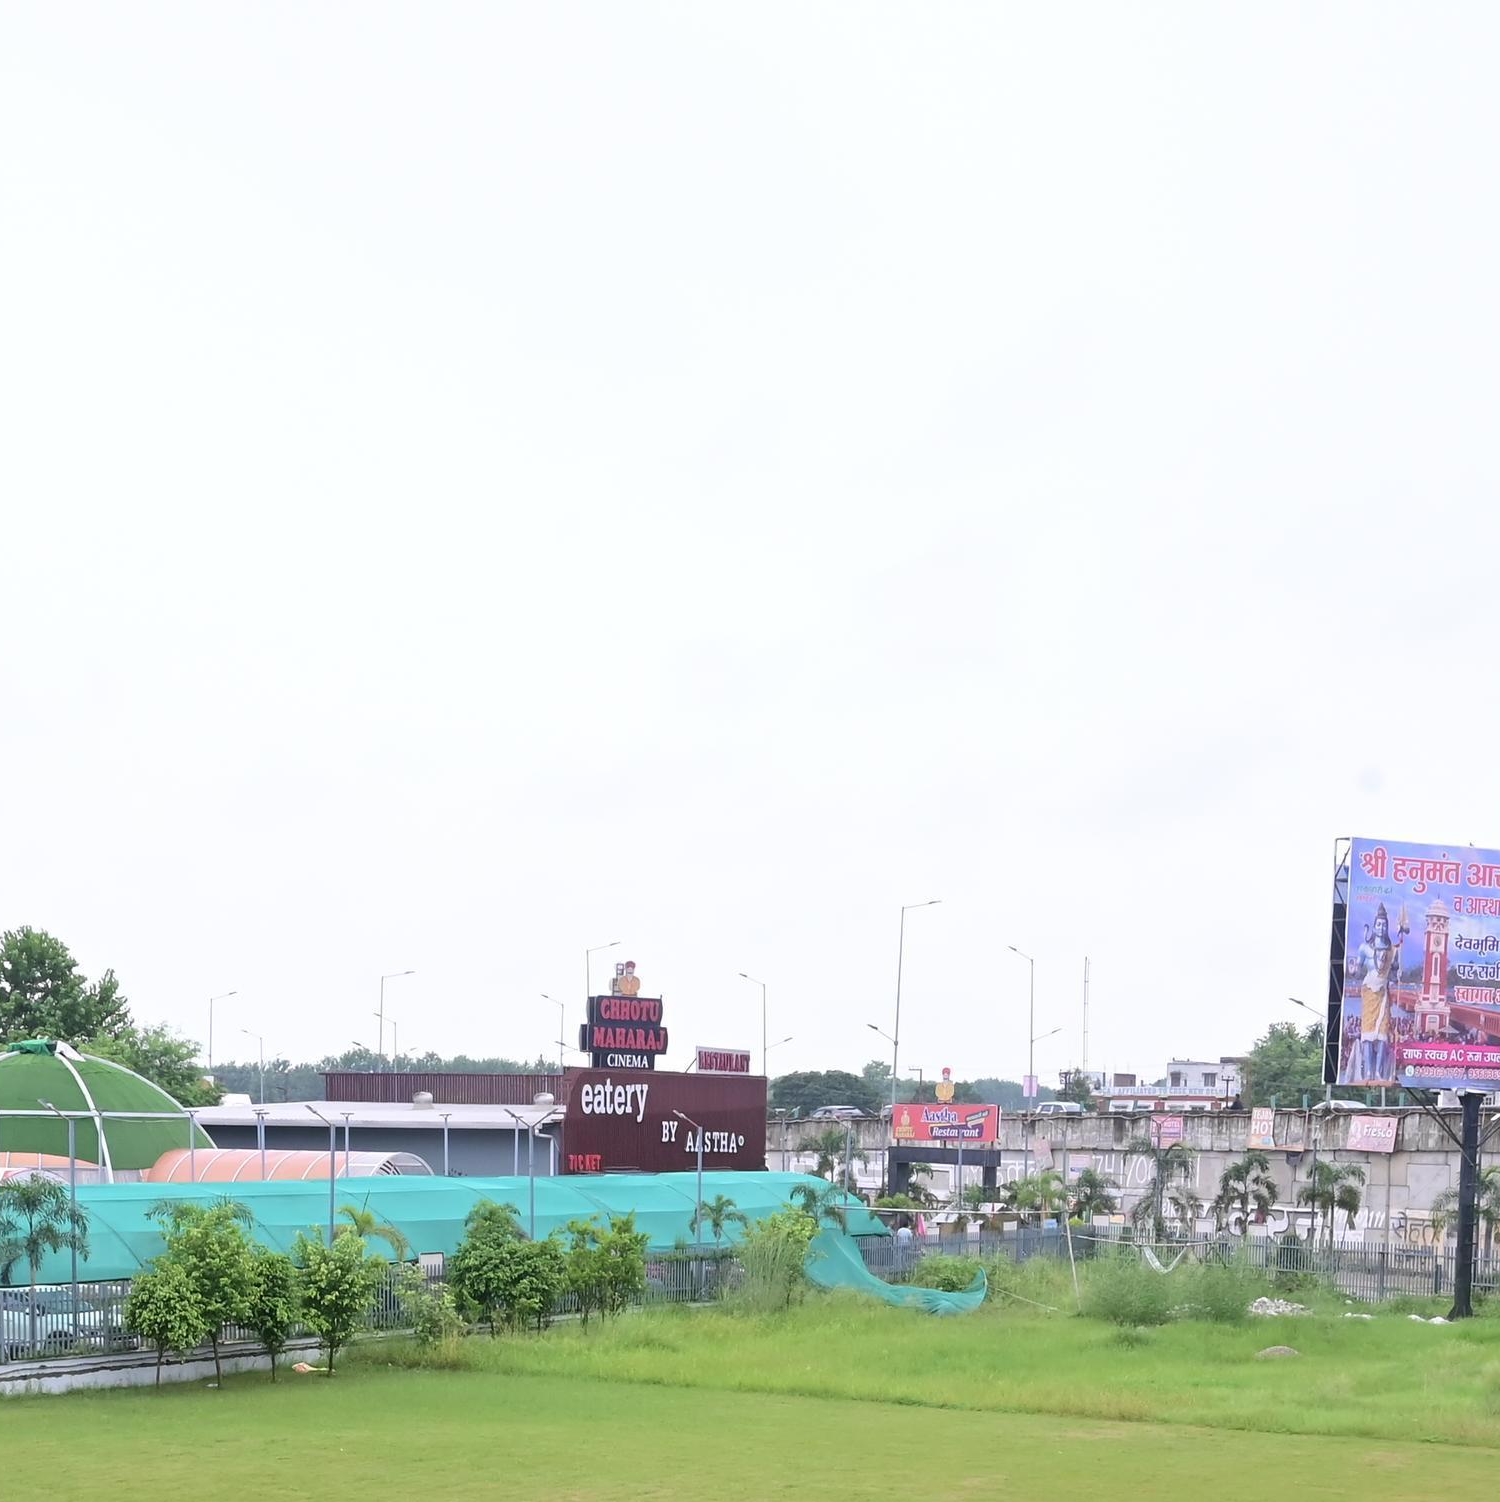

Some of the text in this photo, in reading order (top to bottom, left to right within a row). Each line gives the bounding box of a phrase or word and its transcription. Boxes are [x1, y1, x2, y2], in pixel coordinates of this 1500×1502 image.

[1362, 846, 1387, 879] श्री
[1392, 852, 1461, 893] हनुमंत
[1454, 897, 1463, 914] व
[1466, 896, 1500, 917] आस्था
[1455, 934, 1499, 955] देवभूमि
[601, 999, 660, 1021] CHHOTU
[593, 1026, 665, 1051] MAHARAJ
[607, 1053, 649, 1068] CINEMA
[698, 1050, 750, 1072] RESTAURANT
[1403, 1048, 1422, 1060] साफ
[1450, 1049, 1464, 1061] AC
[581, 1078, 648, 1122] eatery
[922, 1106, 957, 1123] Aastha
[661, 1121, 678, 1142] BY
[685, 1131, 738, 1153] AASTHA
[1364, 1125, 1393, 1138] Fresco
